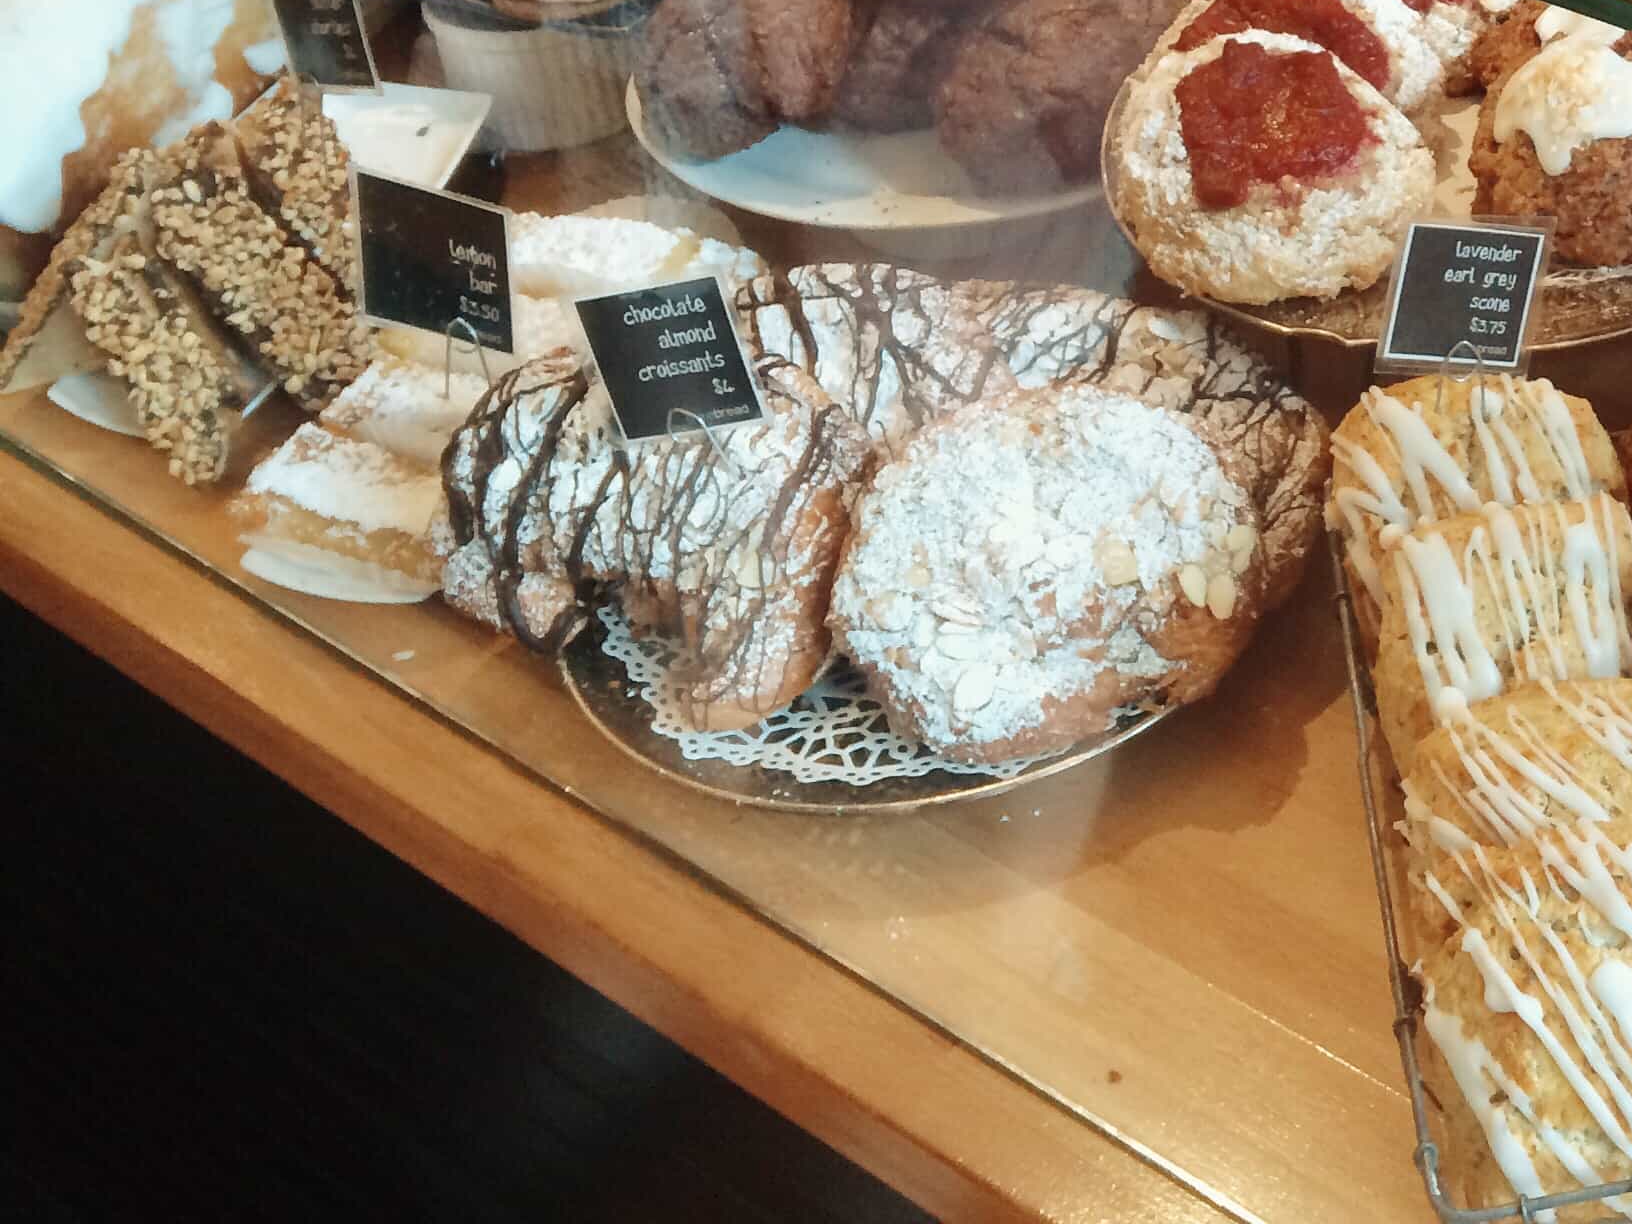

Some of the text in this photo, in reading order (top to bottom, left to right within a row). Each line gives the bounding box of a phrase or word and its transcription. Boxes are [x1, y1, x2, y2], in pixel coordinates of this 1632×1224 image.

[1455, 240, 1523, 263] lavender
[469, 270, 498, 295] bar
[1443, 267, 1518, 292] earl grey
[623, 293, 707, 326] chocolate
[1469, 296, 1511, 313] scone
[657, 319, 717, 350] almond
[1469, 316, 1508, 335] $3.75
[638, 350, 726, 382] croissants
